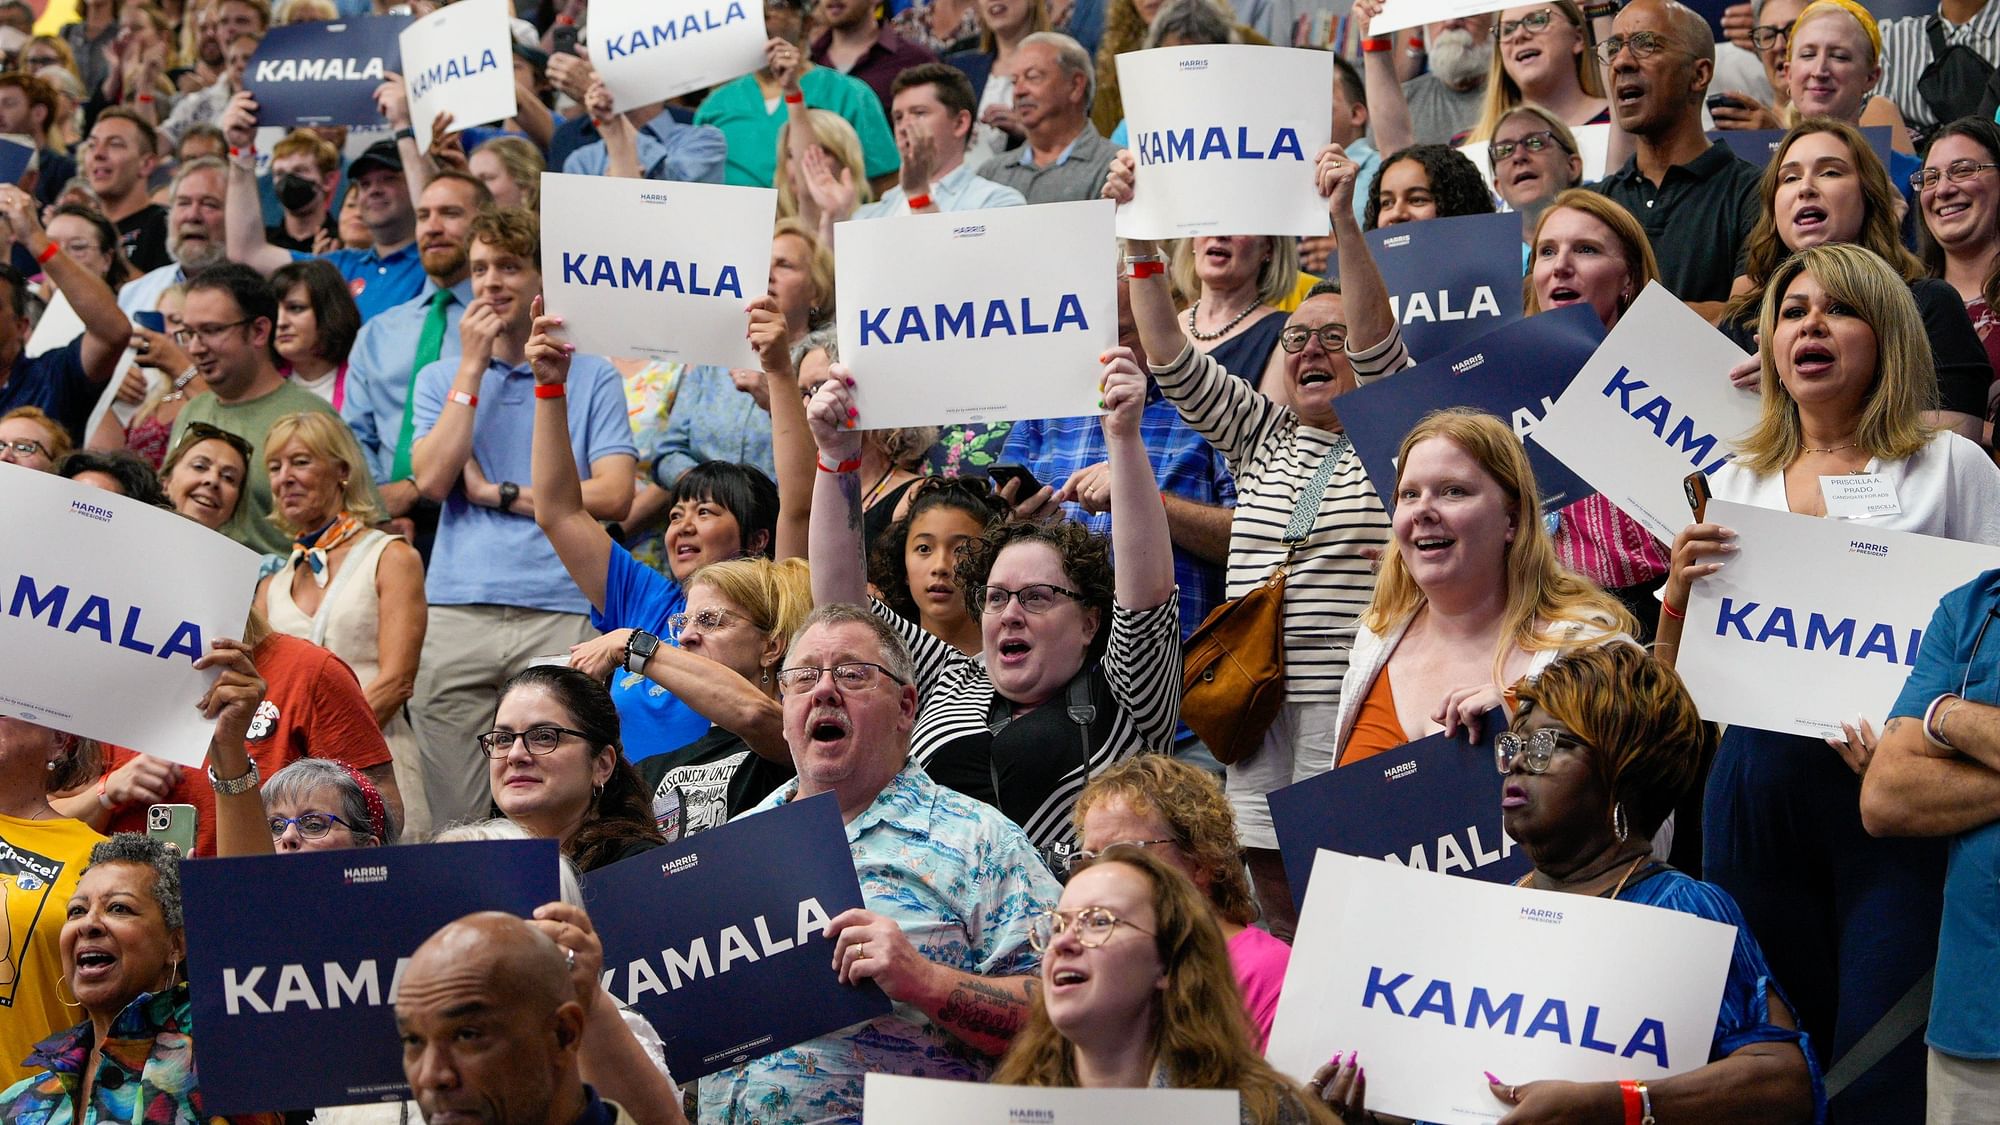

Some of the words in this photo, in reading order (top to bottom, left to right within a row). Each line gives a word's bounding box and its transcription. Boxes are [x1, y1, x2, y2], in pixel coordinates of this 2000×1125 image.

[605, 1, 747, 60] KAMALA
[255, 57, 385, 82] KAMALA
[1179, 59, 1209, 67] HARRIS
[411, 49, 497, 100] KAMALA
[1139, 126, 1304, 166] KAMALA
[640, 193, 668, 201] HARRIS
[562, 252, 743, 299] KAMALA
[1389, 286, 1501, 325] ALA
[859, 294, 1089, 346] KAMALA
[1451, 353, 1484, 372] HARRIS
[1830, 478, 1873, 486] PRISCILLA
[72, 500, 113, 519] HARRIS
[1850, 540, 1889, 553] HARRIS
[0, 574, 203, 665] MALA
[1384, 760, 1417, 778] HARRIS
[656, 769, 708, 799] WISCONSIN
[0, 841, 59, 879] Choice!
[661, 853, 698, 872] HARRIS
[344, 866, 388, 879] HARRIS
[1520, 907, 1564, 920] HARRIS
[1361, 966, 1669, 1069] KAMALA
[1009, 1109, 1055, 1120] HARRIS
